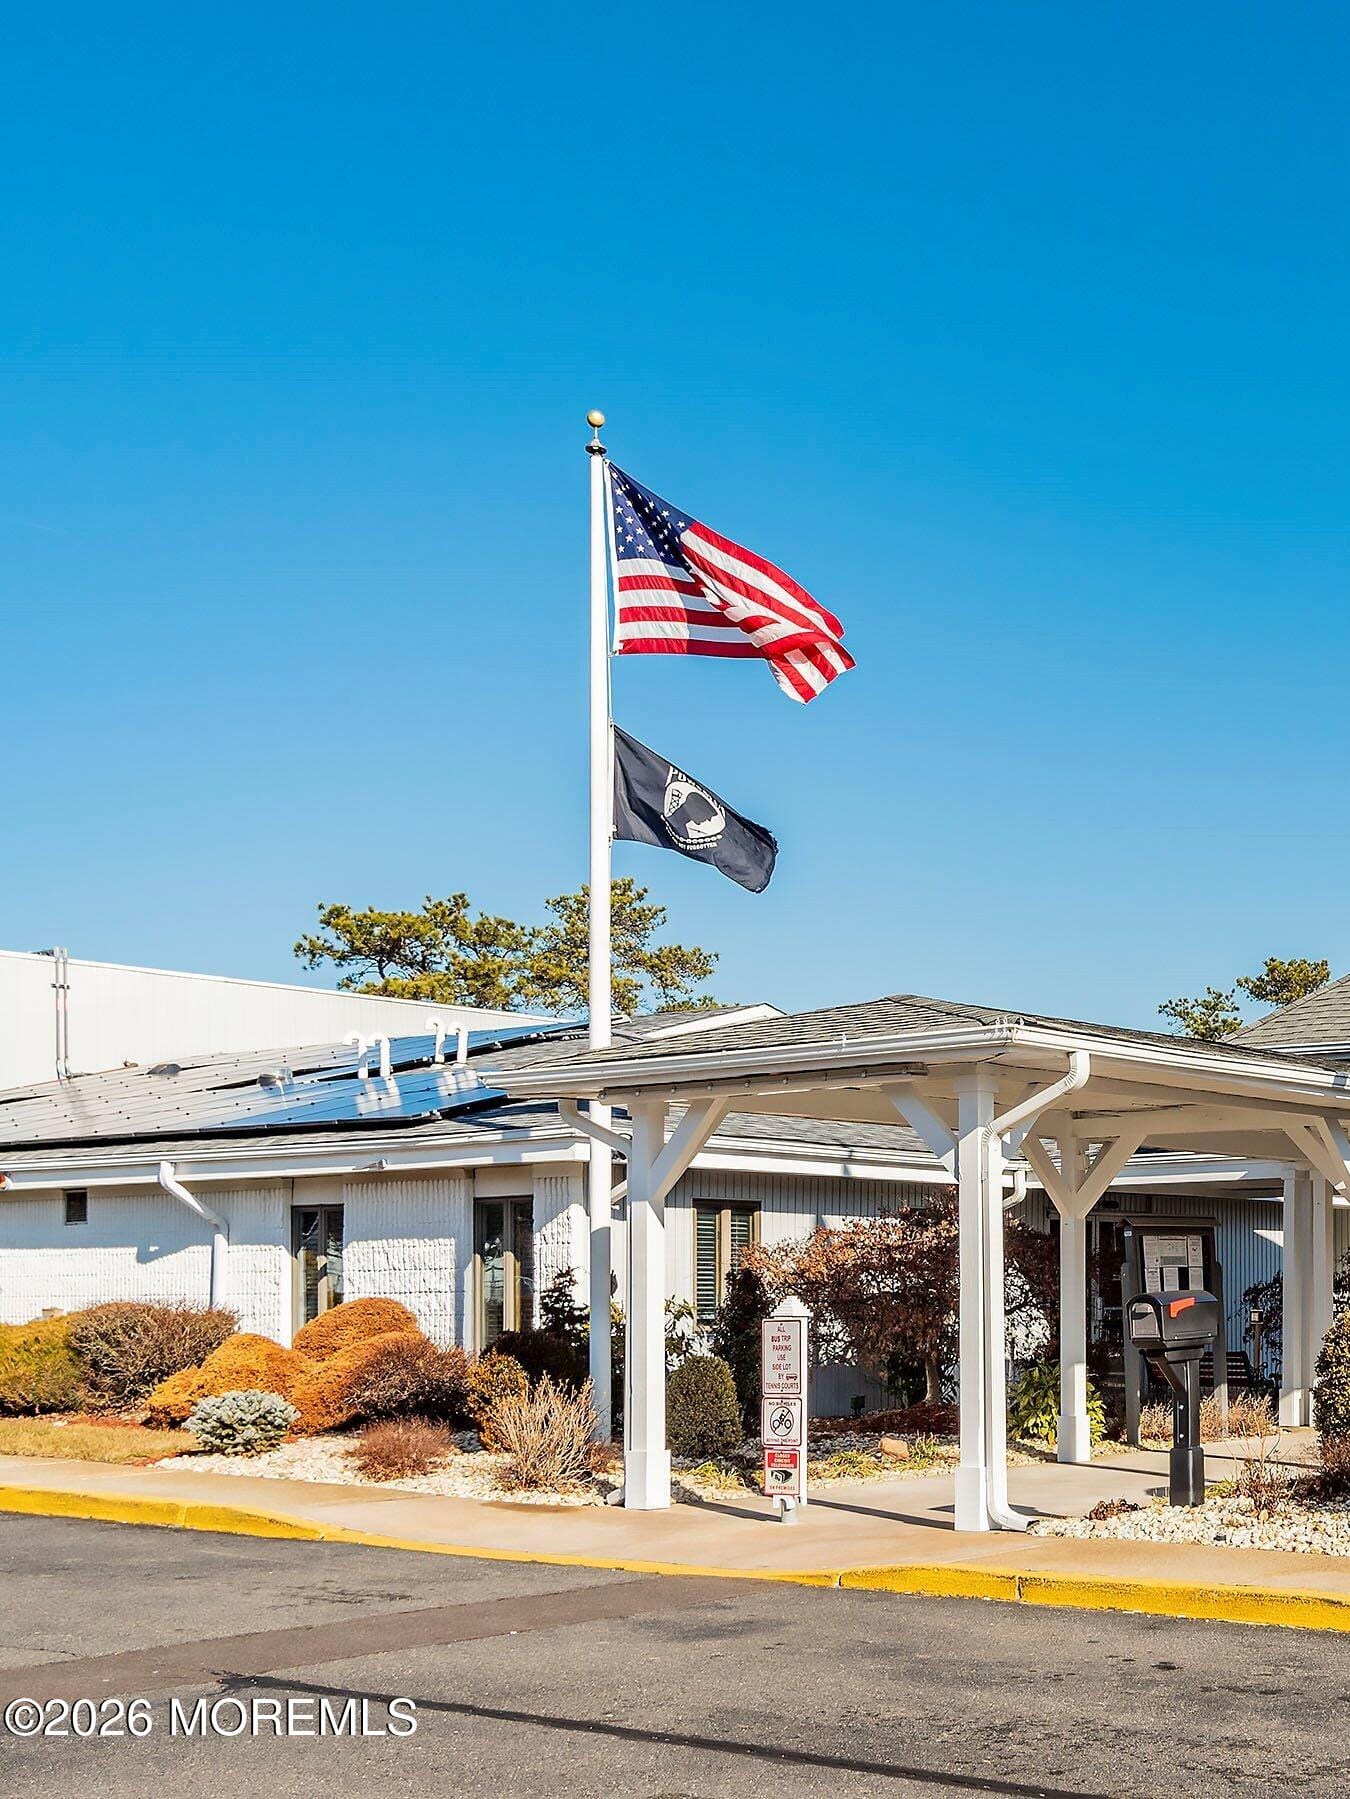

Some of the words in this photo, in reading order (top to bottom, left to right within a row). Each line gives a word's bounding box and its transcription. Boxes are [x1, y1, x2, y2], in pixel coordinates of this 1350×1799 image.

[686, 841, 718, 851] FORGOTTEN
[771, 1335, 781, 1343] BUS
[781, 1334, 792, 1342] TRIP
[772, 1344, 792, 1352] PARKING
[777, 1353, 786, 1361] USE
[772, 1363, 782, 1371] SIDE
[782, 1363, 792, 1371] LOT
[778, 1372, 785, 1380] BY
[765, 1382, 781, 1390] TENNIS
[781, 1382, 799, 1390] COURTS
